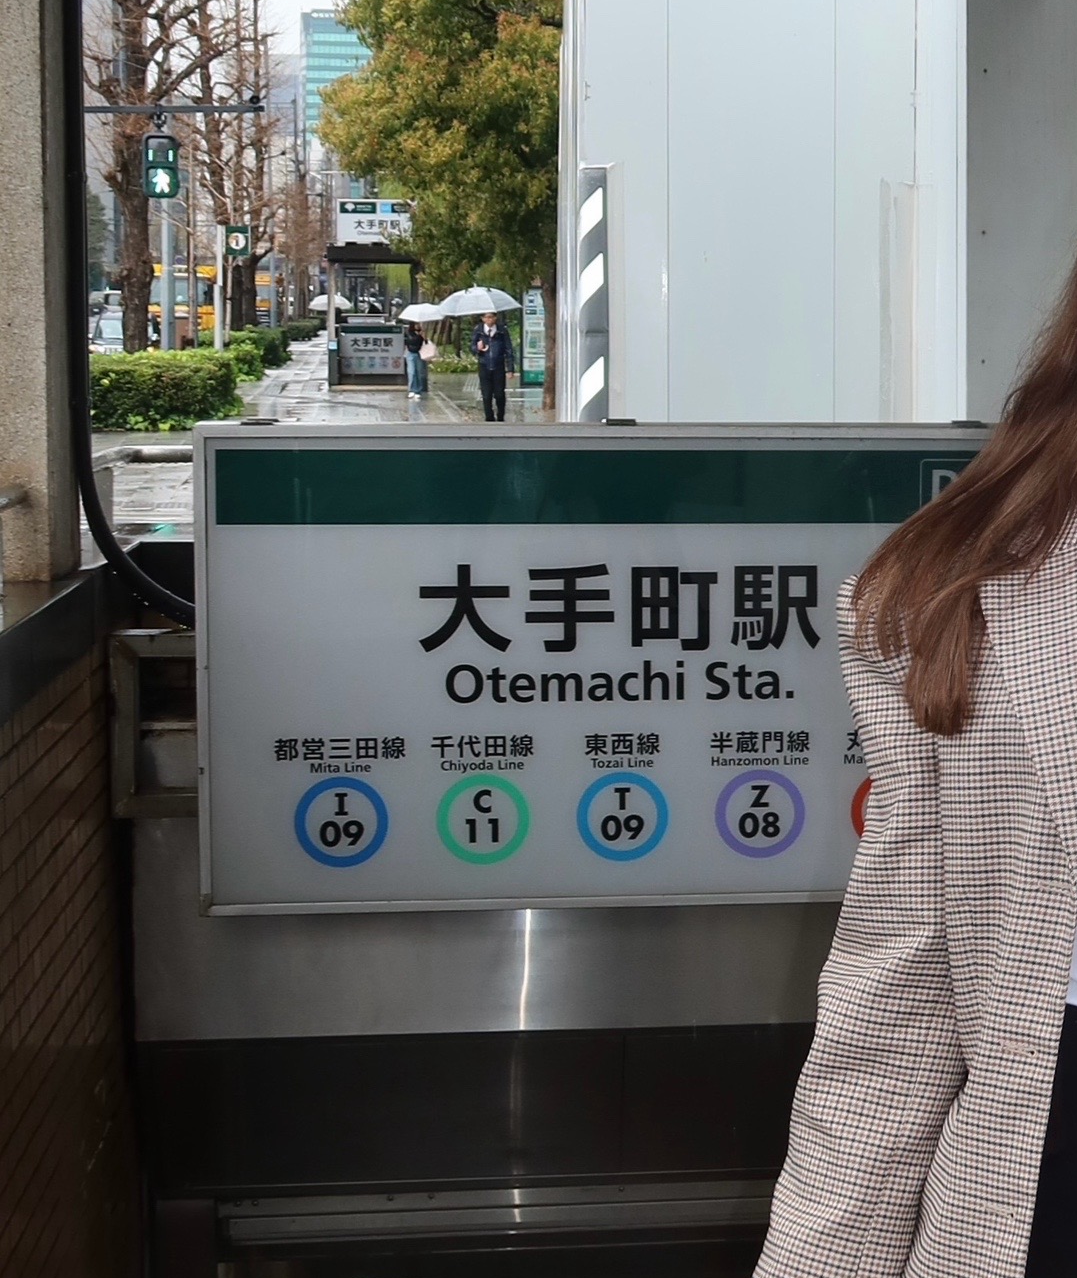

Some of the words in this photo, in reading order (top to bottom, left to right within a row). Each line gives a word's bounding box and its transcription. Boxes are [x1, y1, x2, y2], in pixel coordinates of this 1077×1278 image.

[419, 564, 820, 652] 大手町駅
[446, 660, 685, 703] Otemachi
[706, 660, 794, 700] Sta.
[274, 736, 405, 761] 都営三田線
[431, 734, 533, 758] 千代田線
[585, 732, 660, 756] 東西線
[711, 731, 810, 754] 半蔵門線
[309, 762, 343, 774] Mita
[346, 762, 372, 774] Line
[440, 759, 494, 774] Chiyoda
[497, 759, 524, 771] Line
[590, 757, 626, 769] Tozai
[628, 757, 654, 769] Line
[710, 754, 780, 767] Hanzomon
[783, 754, 810, 766] Line
[473, 790, 492, 814] C
[615, 788, 631, 810] T
[751, 785, 770, 807] Z
[320, 820, 364, 848] 09
[465, 819, 500, 843] 11
[600, 814, 645, 841] 09
[738, 811, 781, 839] 08
